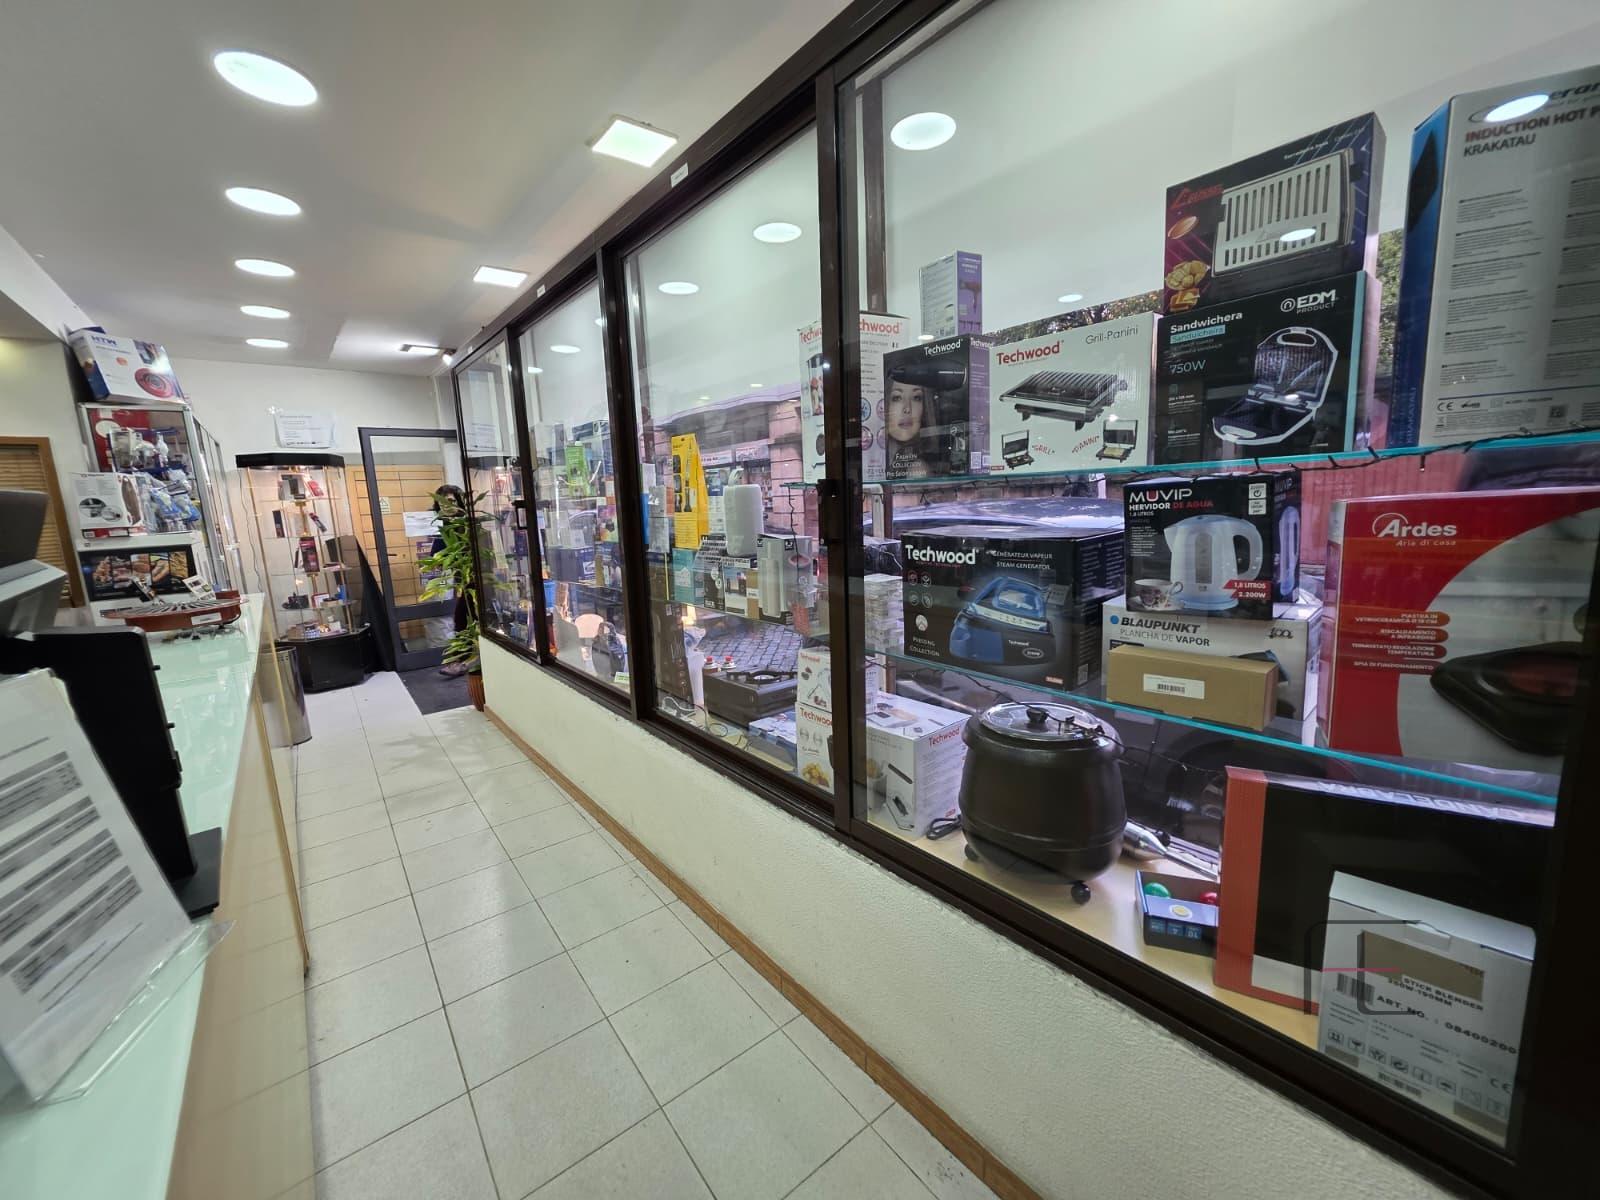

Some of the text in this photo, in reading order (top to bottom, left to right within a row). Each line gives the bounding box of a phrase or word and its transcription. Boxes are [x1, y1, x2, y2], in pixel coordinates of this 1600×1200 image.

[1465, 115, 1549, 143] INDUCTION
[1553, 108, 1585, 126] HOT
[1463, 133, 1537, 157] KRAKATAU
[1296, 302, 1336, 315] PRODUCT
[1297, 289, 1336, 309] EDM
[1170, 312, 1243, 334] Sandwichera
[1085, 326, 1139, 345] Grill-Panini
[924, 340, 962, 356] Techwood
[996, 342, 1061, 365] Techwood
[1169, 359, 1206, 375] 750W
[1129, 488, 1193, 503] MUVIP
[1129, 502, 1171, 512] HERVIDOR
[1378, 518, 1457, 538] Ardes
[905, 544, 977, 566] Techwood
[1120, 616, 1201, 635] BLAUPUNKT
[1119, 628, 1210, 647] PLANCHA DE VAPOR
[799, 707, 833, 727] Techwoo
[929, 727, 961, 748] Techwood
[1403, 977, 1484, 1011] STICK BLENDER
